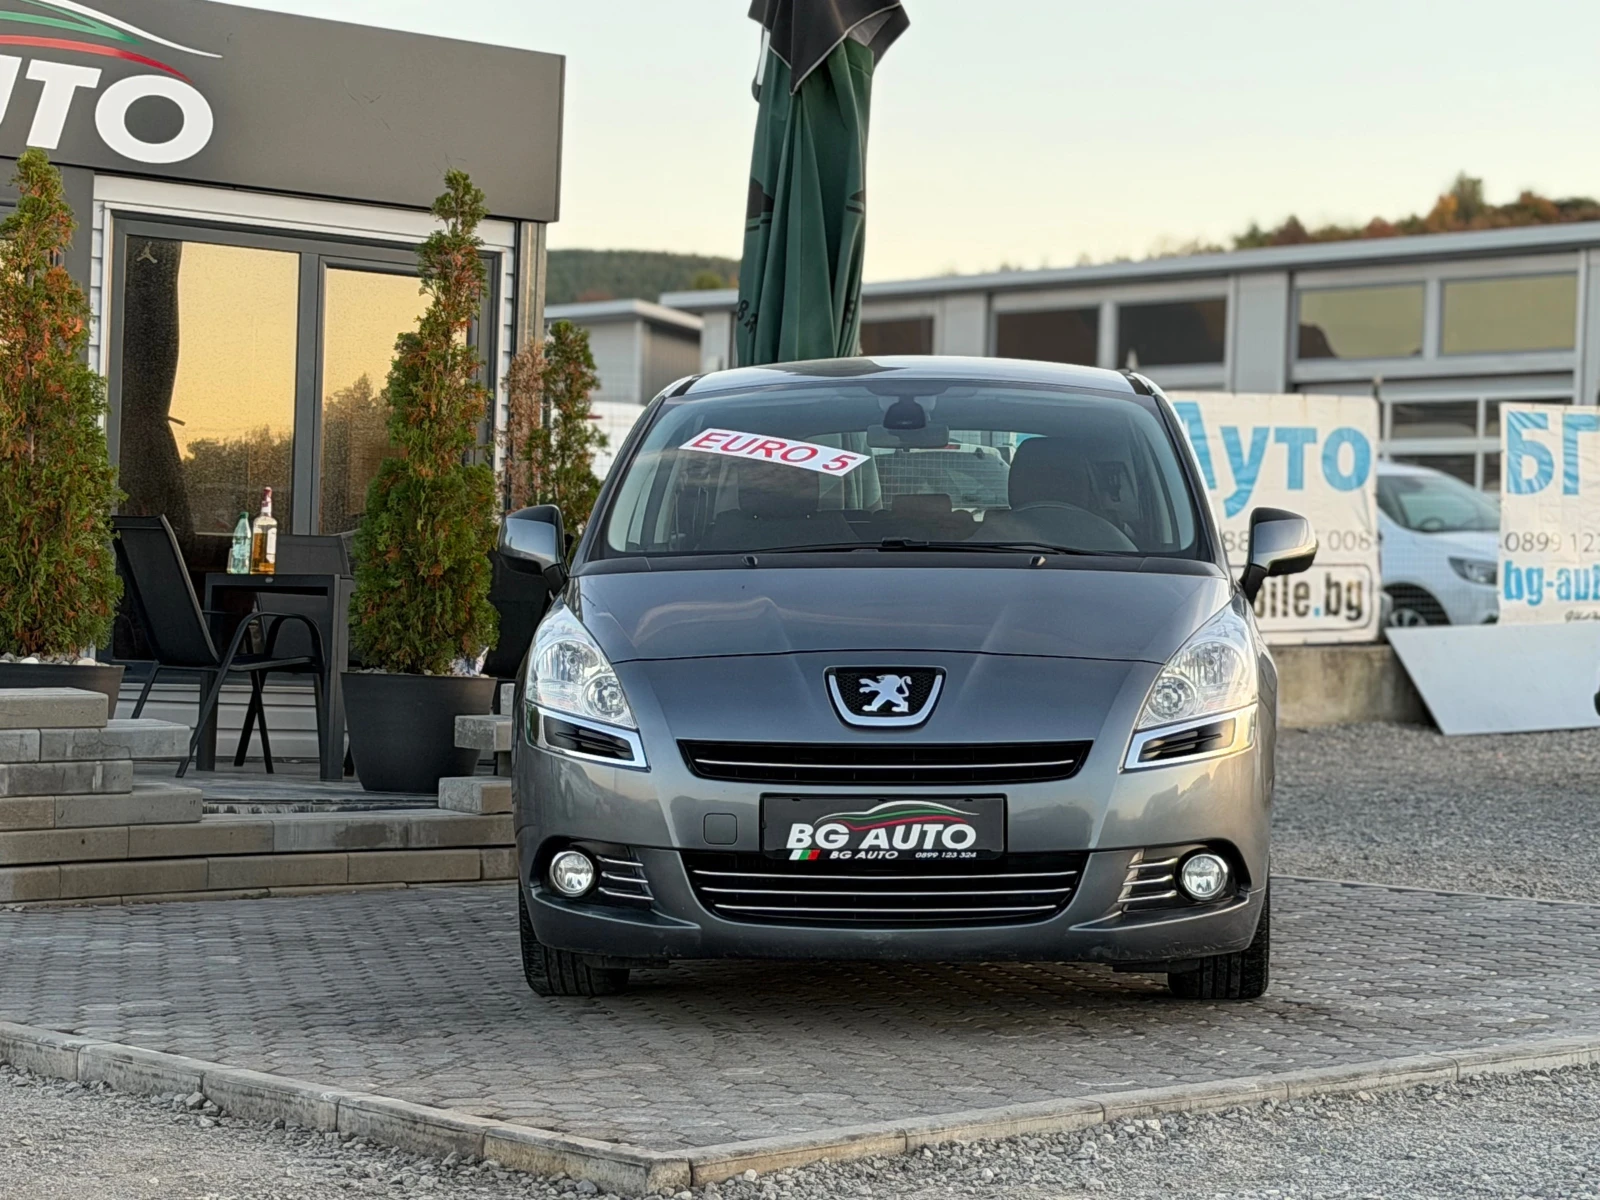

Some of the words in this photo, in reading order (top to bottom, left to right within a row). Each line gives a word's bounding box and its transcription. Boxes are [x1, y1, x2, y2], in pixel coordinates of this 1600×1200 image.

[690, 432, 819, 463] EURO
[821, 454, 858, 471] 5
[1505, 531, 1562, 553] 0899
[1570, 532, 1600, 553] 12
[786, 823, 850, 849] BG
[858, 823, 977, 850] AUTO
[829, 850, 852, 859] BG
[854, 850, 899, 859] AUTO
[915, 851, 939, 859] 0899
[941, 851, 957, 859] 123
[959, 851, 977, 859] 324
